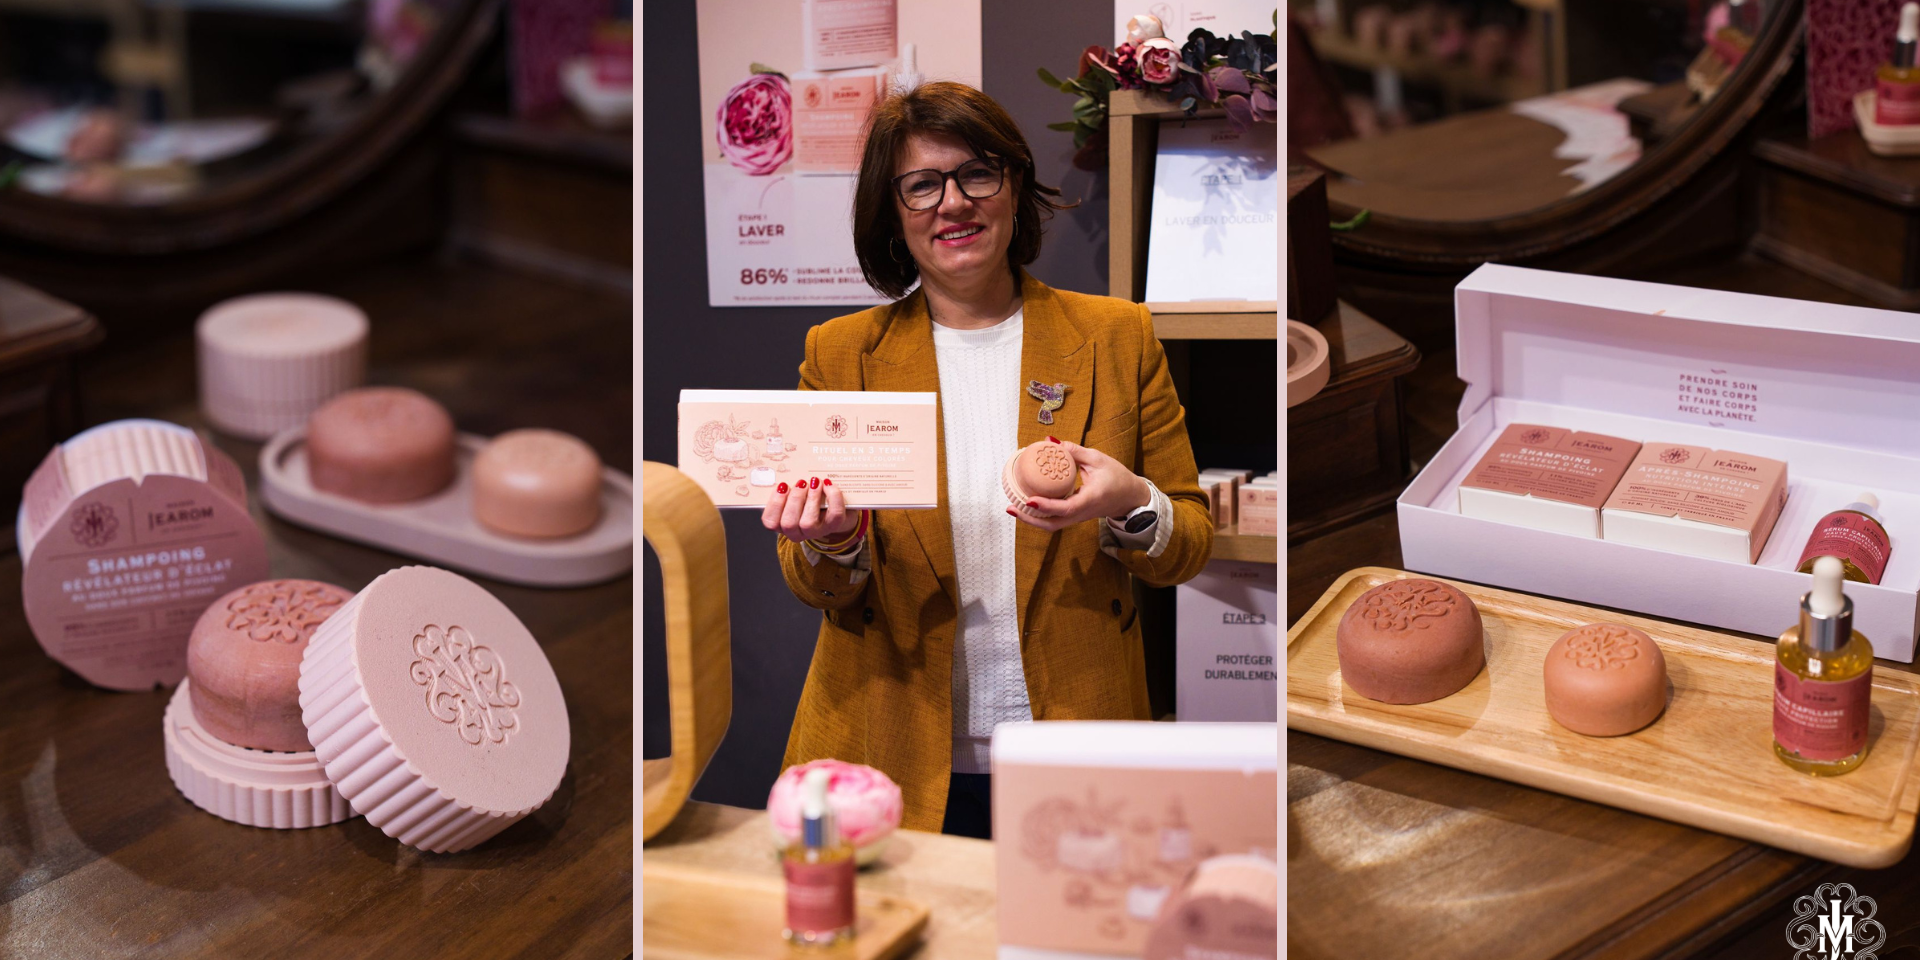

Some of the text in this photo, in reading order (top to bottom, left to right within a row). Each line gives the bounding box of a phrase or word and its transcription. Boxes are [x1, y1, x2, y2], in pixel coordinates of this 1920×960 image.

[1165, 214, 1275, 227] LAVER EN DOUCEUR
[738, 224, 785, 238] LAVER
[833, 266, 844, 275] LA
[1680, 374, 1757, 391] PRENDRE SOIN
[1679, 384, 1757, 402] DE NOS CORPS
[1679, 394, 1757, 412] ET FAIRE CORPS
[1678, 405, 1756, 422] AVEC LA PLANÈTE.
[866, 424, 899, 434] JEAROM
[812, 445, 911, 454] RITUEL EN 3 TEMPS
[1571, 440, 1613, 452] JEAROM
[1499, 452, 1604, 473] RÉVÉLATEUR D'ÉCLAT
[1519, 447, 1592, 465] SHAMPOING
[1713, 459, 1757, 472] JEAROM
[1638, 465, 1760, 490] APRÈS-SHAMPOING
[1646, 473, 1746, 494] NUTRITION INTENSE
[148, 506, 215, 531] JEAROM
[87, 546, 206, 575] SHAMPOING
[62, 558, 233, 593] RÉVÉLATEUR D'ÉCLAT
[1222, 611, 1266, 625] ÉTAPE 3
[1216, 653, 1273, 666] PROTÉGER
[1791, 702, 1845, 717] CAPILLAIRE
